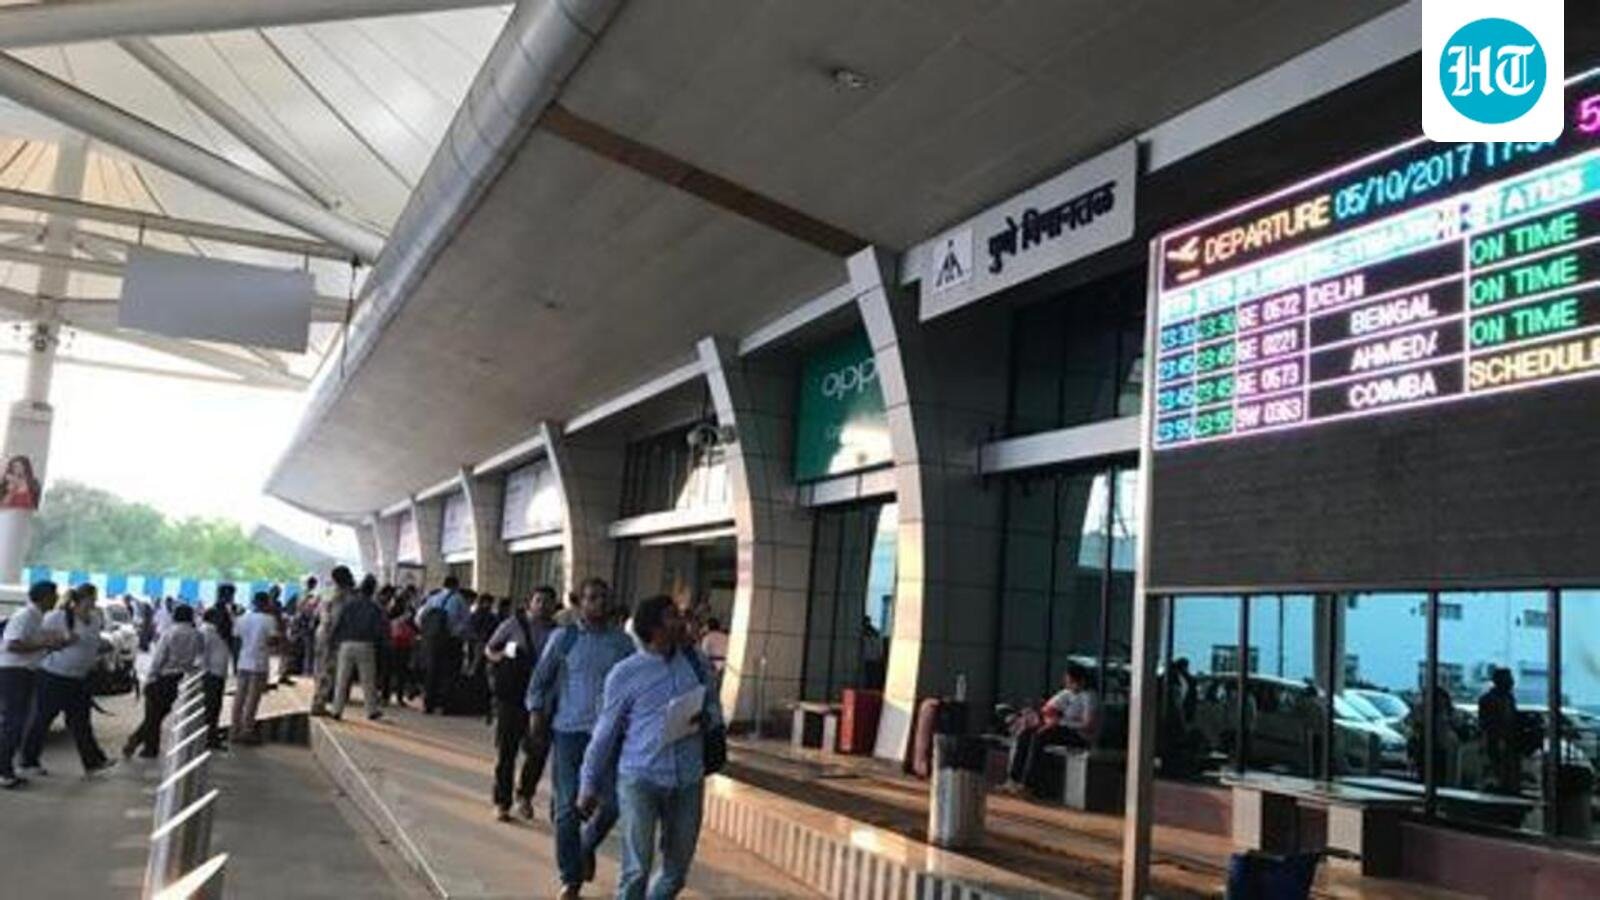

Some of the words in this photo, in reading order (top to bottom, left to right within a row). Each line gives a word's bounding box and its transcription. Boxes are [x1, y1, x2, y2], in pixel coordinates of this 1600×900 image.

[1204, 194, 1331, 264] DEPARTURE
[1335, 143, 1474, 220] 05/10/2017
[988, 216, 1018, 274] पुणे
[1308, 275, 1365, 309] DELHI
[1471, 234, 1505, 264] ON
[1511, 213, 1579, 252] TIME
[1350, 293, 1439, 334] BENGAL
[1471, 276, 1505, 305] ON
[1511, 256, 1579, 294] TIME
[1471, 316, 1504, 346] ON
[1511, 298, 1579, 337] TIME
[822, 358, 876, 401] opp
[1349, 371, 1438, 409] COIMBA
